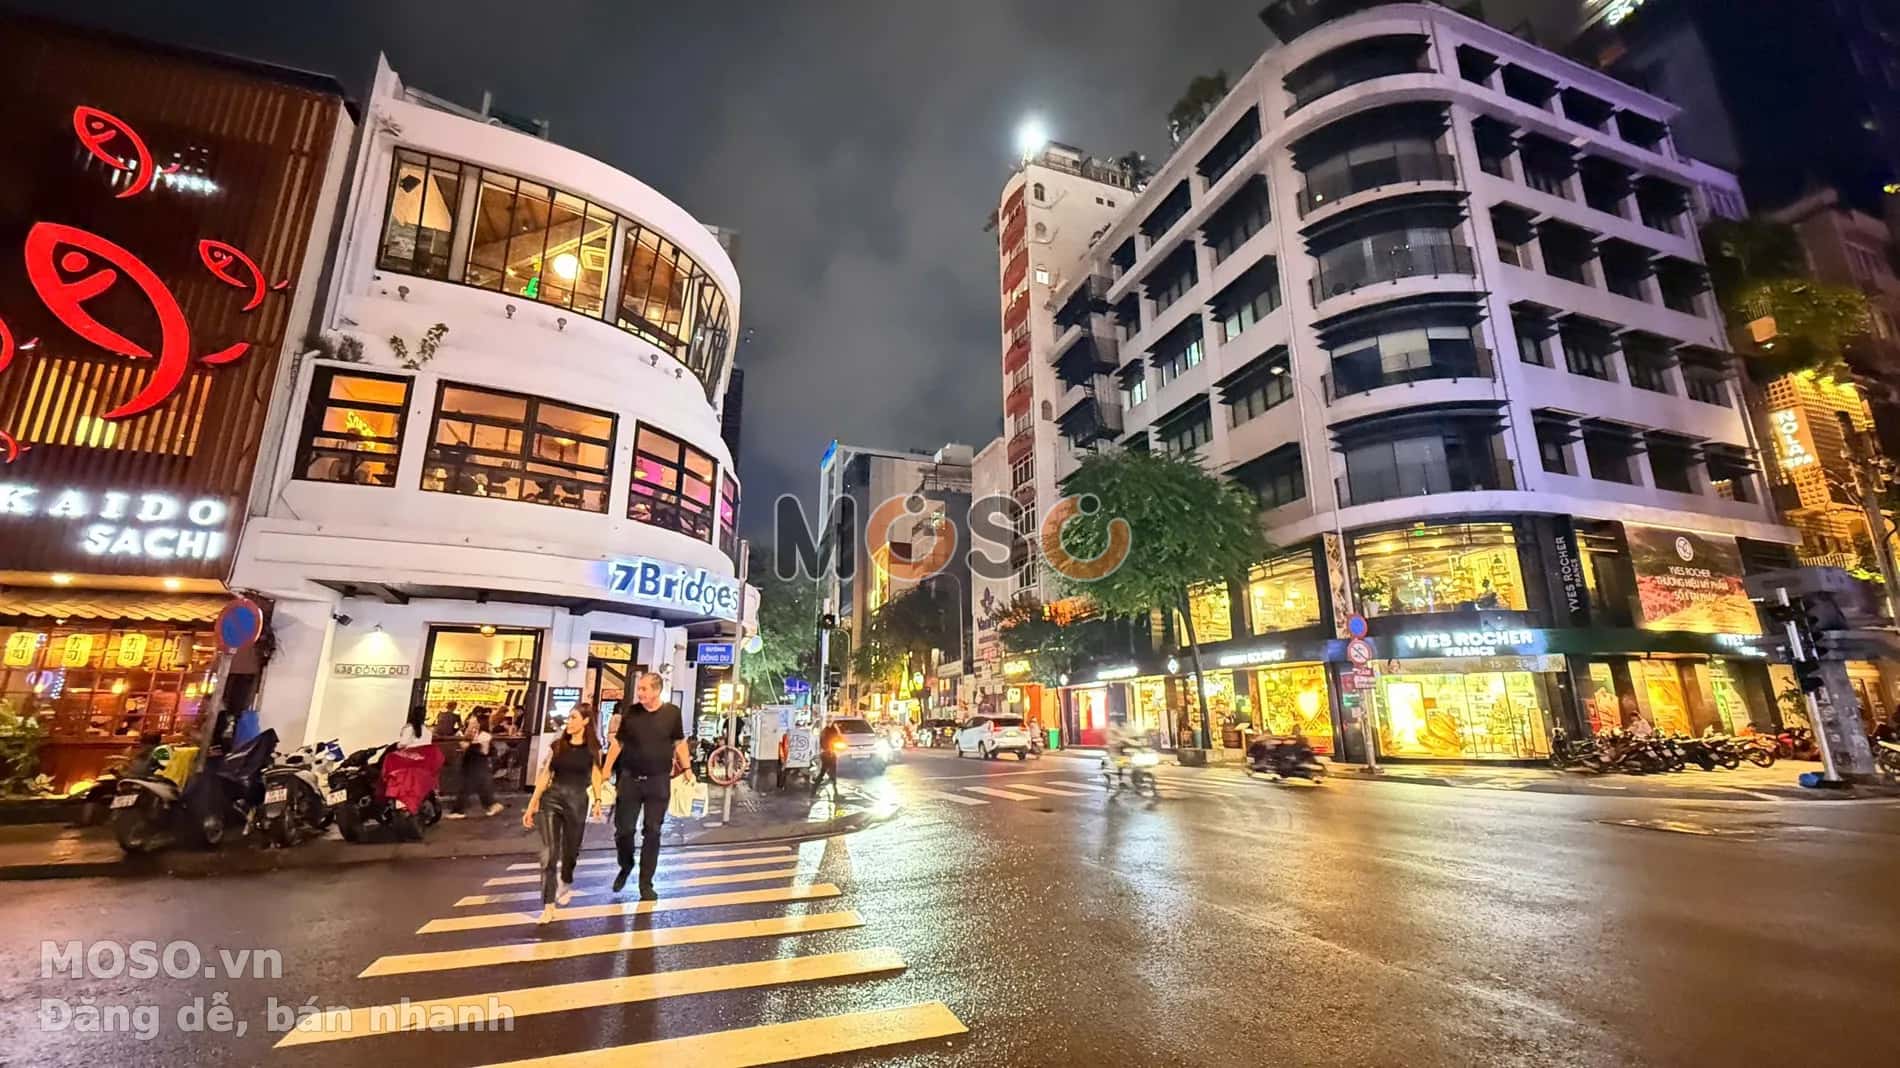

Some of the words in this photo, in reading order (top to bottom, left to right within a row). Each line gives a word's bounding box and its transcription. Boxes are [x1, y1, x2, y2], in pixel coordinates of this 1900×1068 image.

[83, 524, 226, 558] SACHI
[1555, 536, 1573, 582] ROCHER
[610, 561, 738, 615] 7Bridges
[1566, 583, 1581, 613] YVES
[1406, 633, 1451, 649] YVES
[1454, 630, 1533, 648] ROCHER
[1444, 646, 1496, 657] FRANCE
